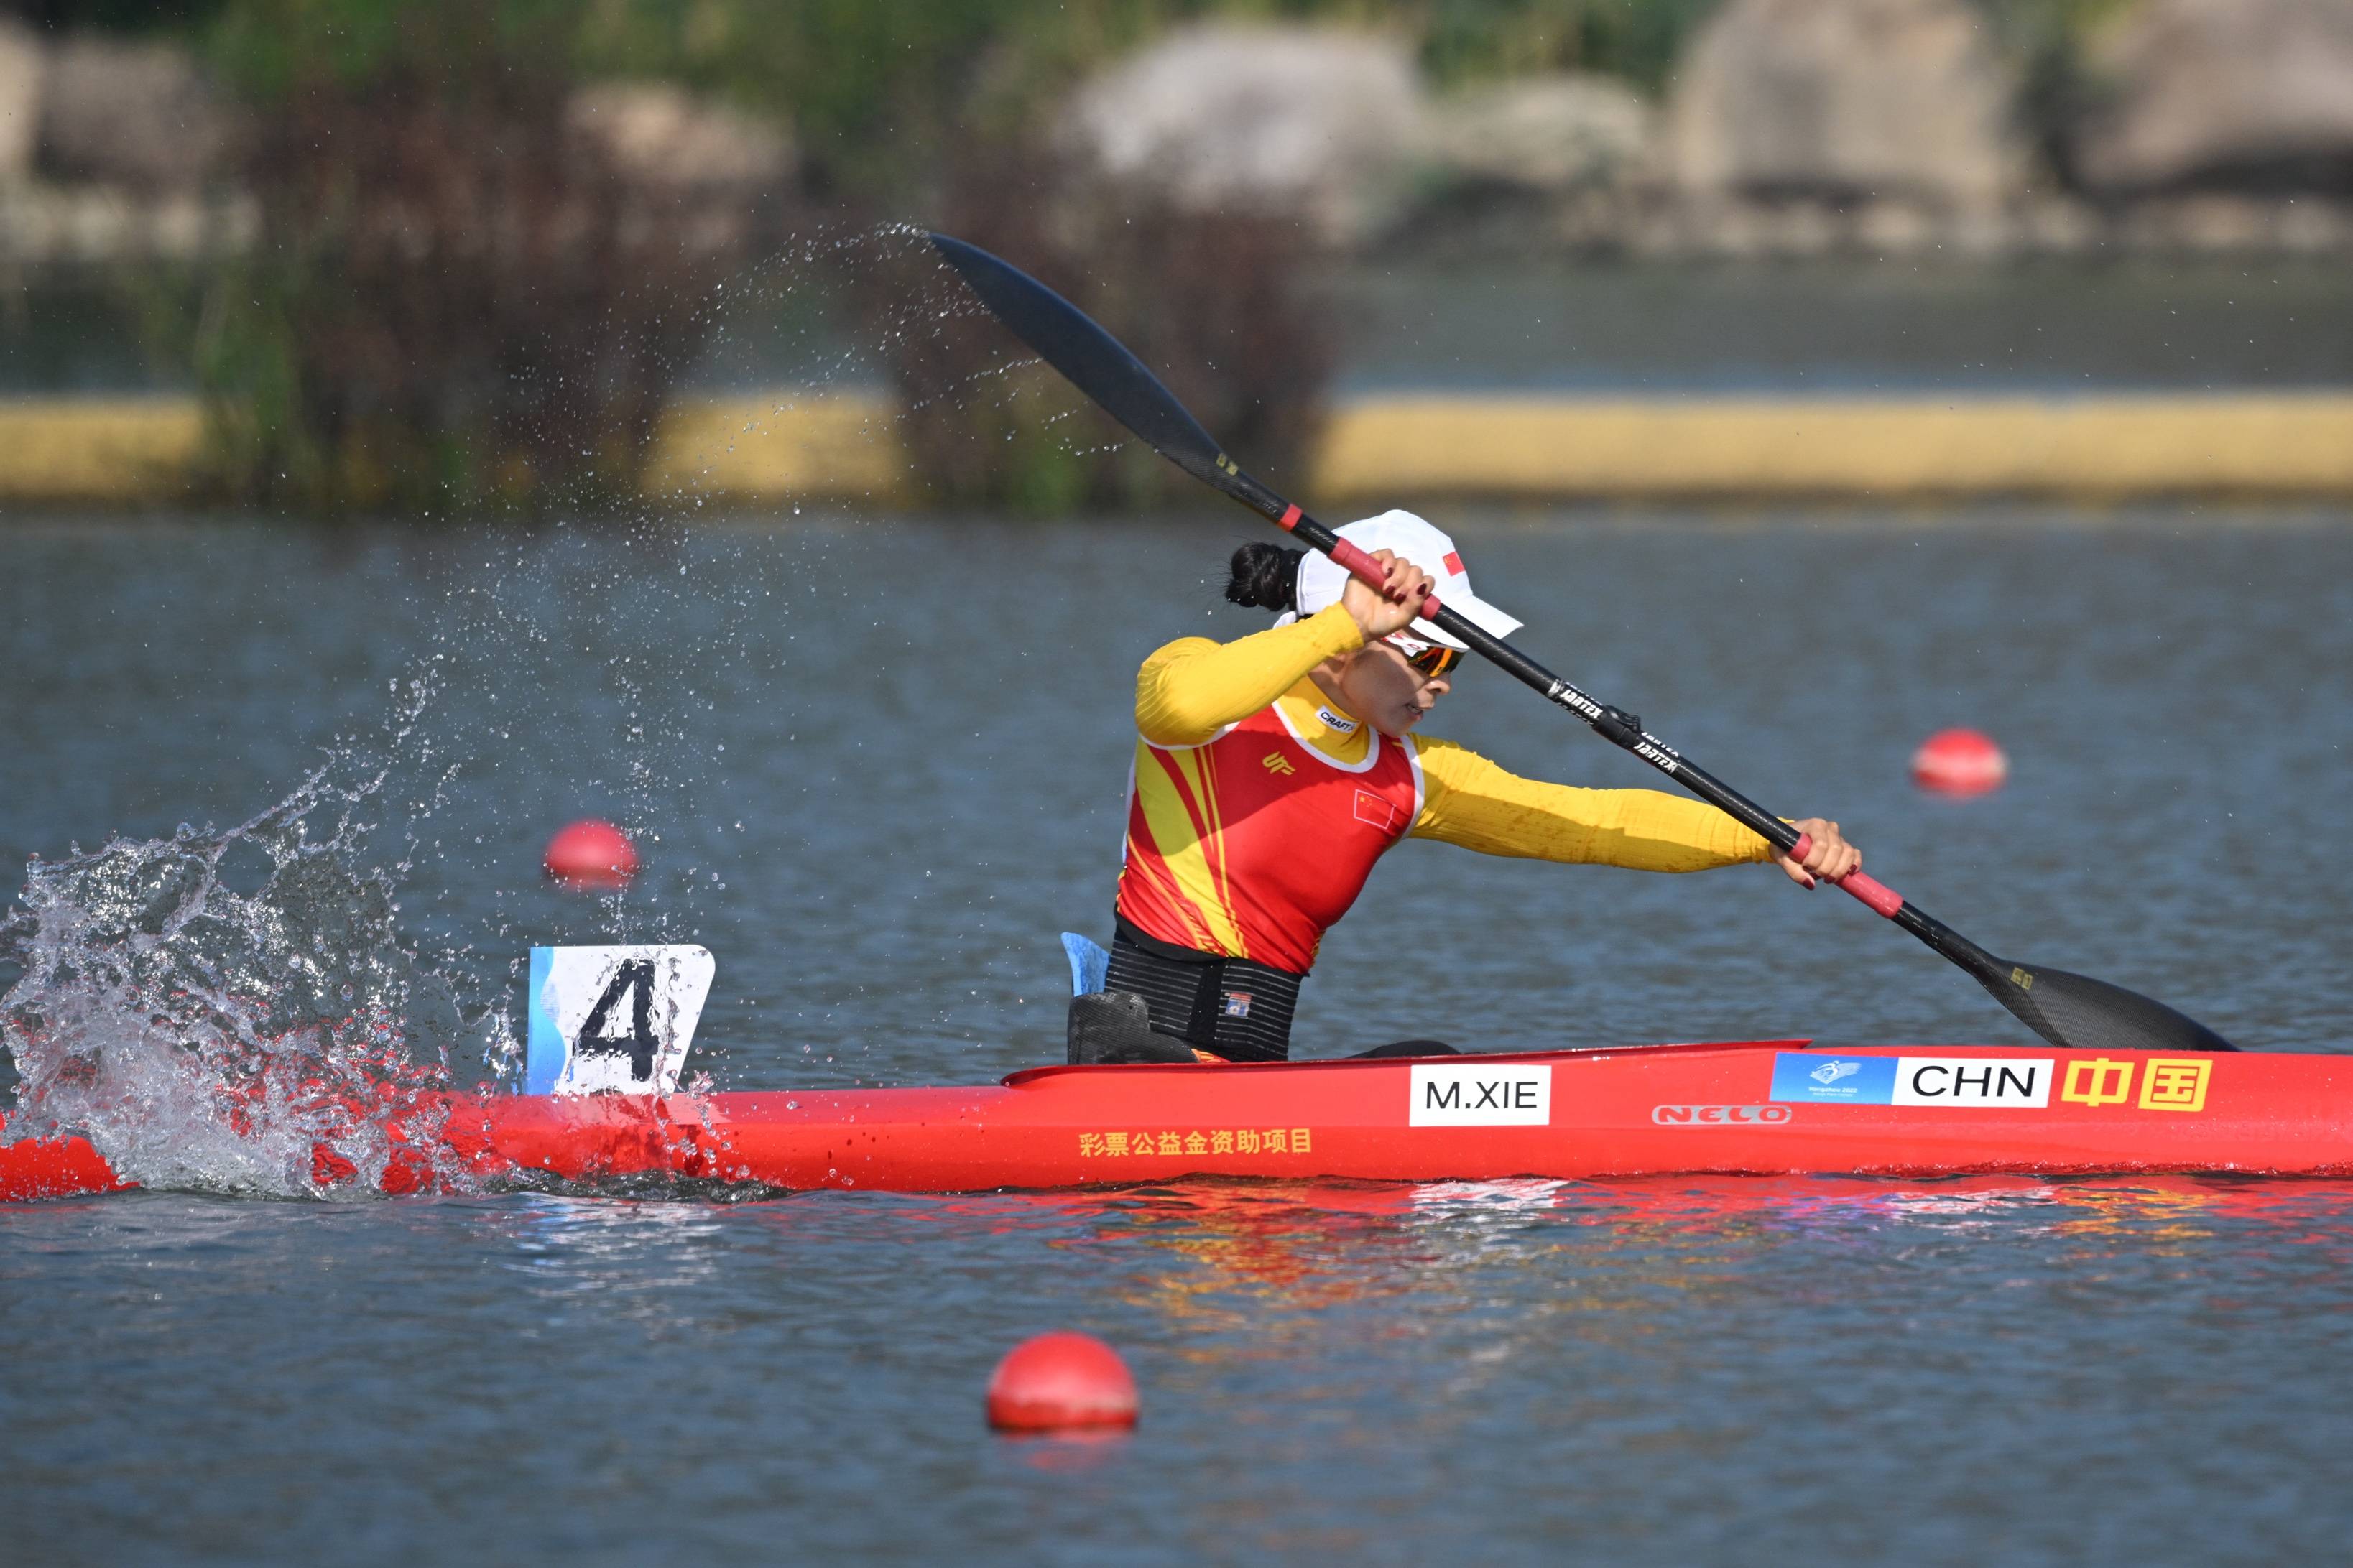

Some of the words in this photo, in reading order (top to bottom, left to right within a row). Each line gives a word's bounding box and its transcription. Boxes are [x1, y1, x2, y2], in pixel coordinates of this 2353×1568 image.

[1321, 712, 1352, 730] CRAFT
[574, 957, 660, 1082] 4
[1426, 1081, 1538, 1109] M.XIE
[1912, 1065, 2036, 1098] CHN
[2061, 1057, 2214, 1112] 中国
[1658, 1107, 1788, 1123] NELO
[1078, 1128, 1313, 1158] 彩票公益金资助项目
